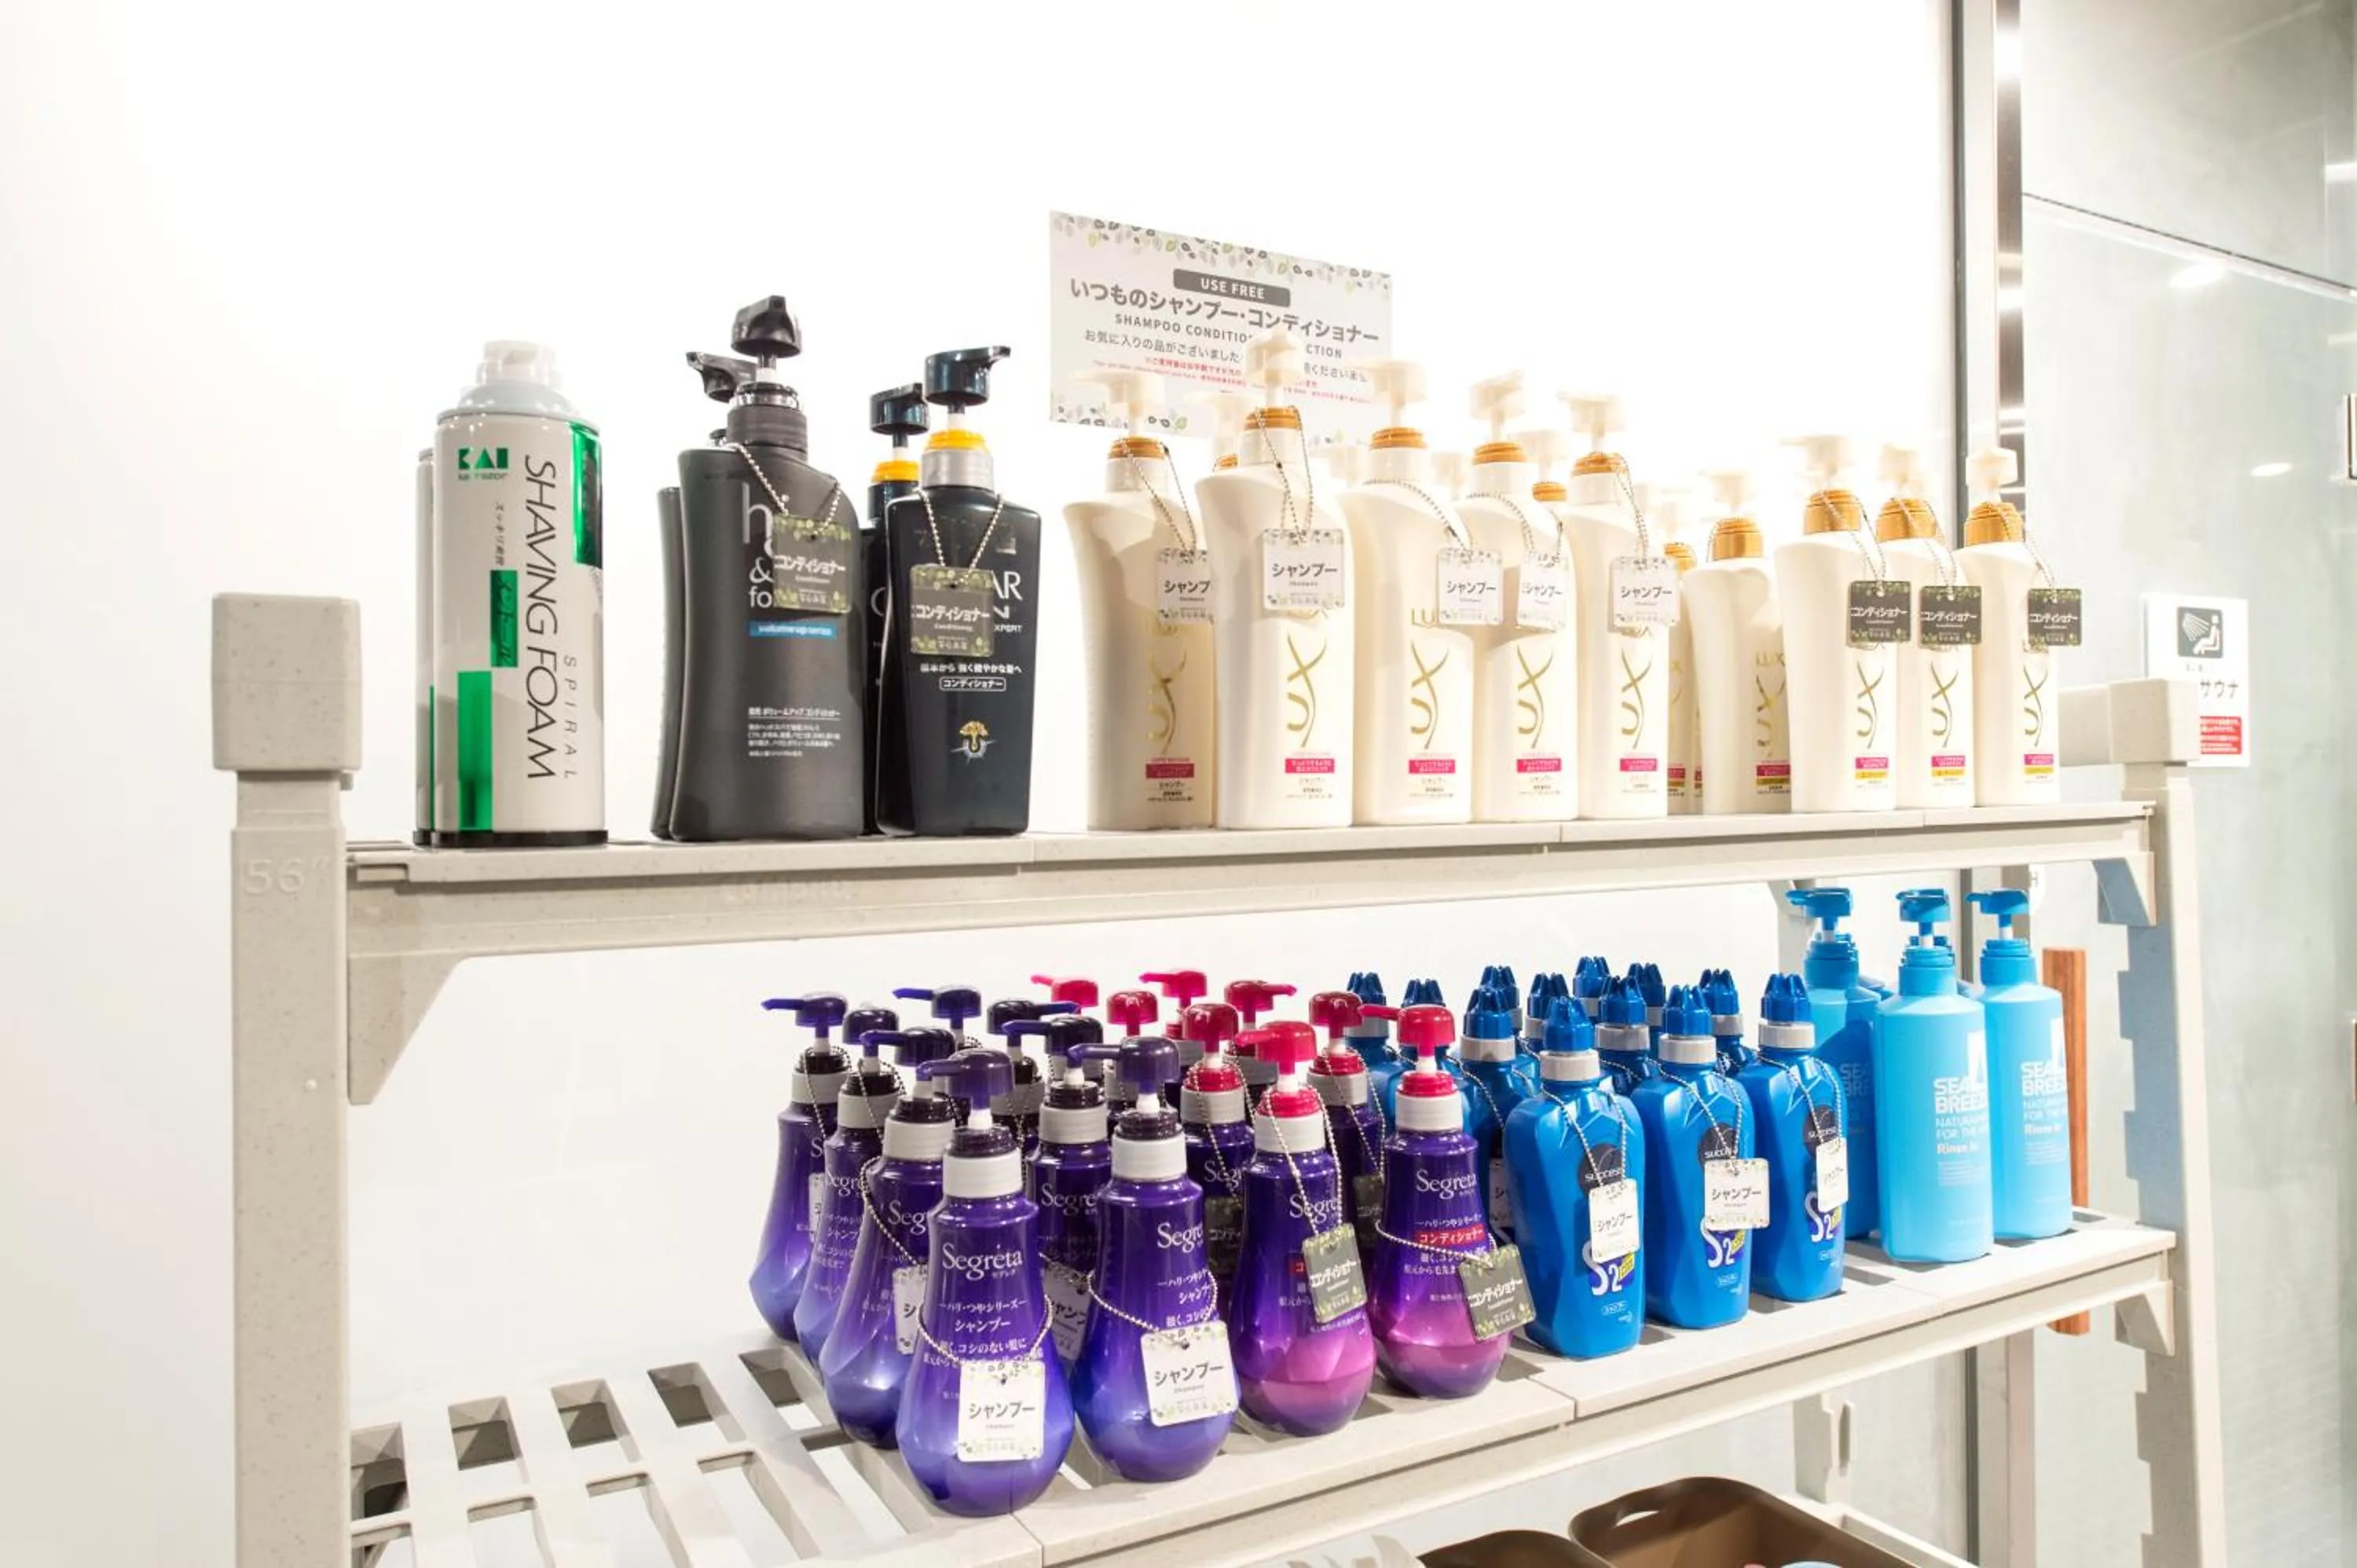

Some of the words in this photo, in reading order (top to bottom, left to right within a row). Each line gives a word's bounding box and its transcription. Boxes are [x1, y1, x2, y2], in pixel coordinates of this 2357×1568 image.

[1200, 278, 1228, 293] USE
[1231, 281, 1264, 299] FREE
[1071, 279, 1379, 343] いつものシャンプー・コンディショナー
[1115, 313, 1181, 333] SHAMPOO
[1186, 324, 1253, 343] CONDITIO
[458, 447, 508, 470] KAI
[525, 454, 558, 635] SHAVING
[774, 555, 846, 574] コンディショナー
[1271, 562, 1337, 577] シャンプー
[1164, 580, 1211, 594] シャンプ
[1446, 581, 1497, 595] シャンプー
[1526, 583, 1563, 598] シャンプー
[1620, 586, 1673, 599] シャンプー
[748, 586, 773, 608] fo
[915, 605, 991, 621] コンディショナー
[1411, 608, 1436, 625] LU
[1852, 606, 1908, 617] コンディショナー
[1923, 611, 1978, 621] コンディショナー
[2030, 613, 2078, 624] コンディショナー
[994, 624, 1023, 633] XPERT
[1756, 651, 1785, 667] LUX
[943, 680, 1004, 689] コンディショナー
[526, 647, 558, 779] FOAM
[564, 655, 577, 779] SPIRAL
[1041, 1184, 1098, 1216] Segre
[1712, 1188, 1762, 1200] シャンプー
[1597, 1214, 1633, 1232] シャンプー
[1420, 1229, 1483, 1244] コンディショナー
[943, 1243, 1023, 1280] Segreta
[1310, 1260, 1357, 1288] コンディショナー
[1468, 1279, 1523, 1307] コンディショナー
[955, 1317, 1011, 1333] シャンプー
[1154, 1362, 1224, 1387] シャンプー
[970, 1401, 1035, 1419] シャンプー
